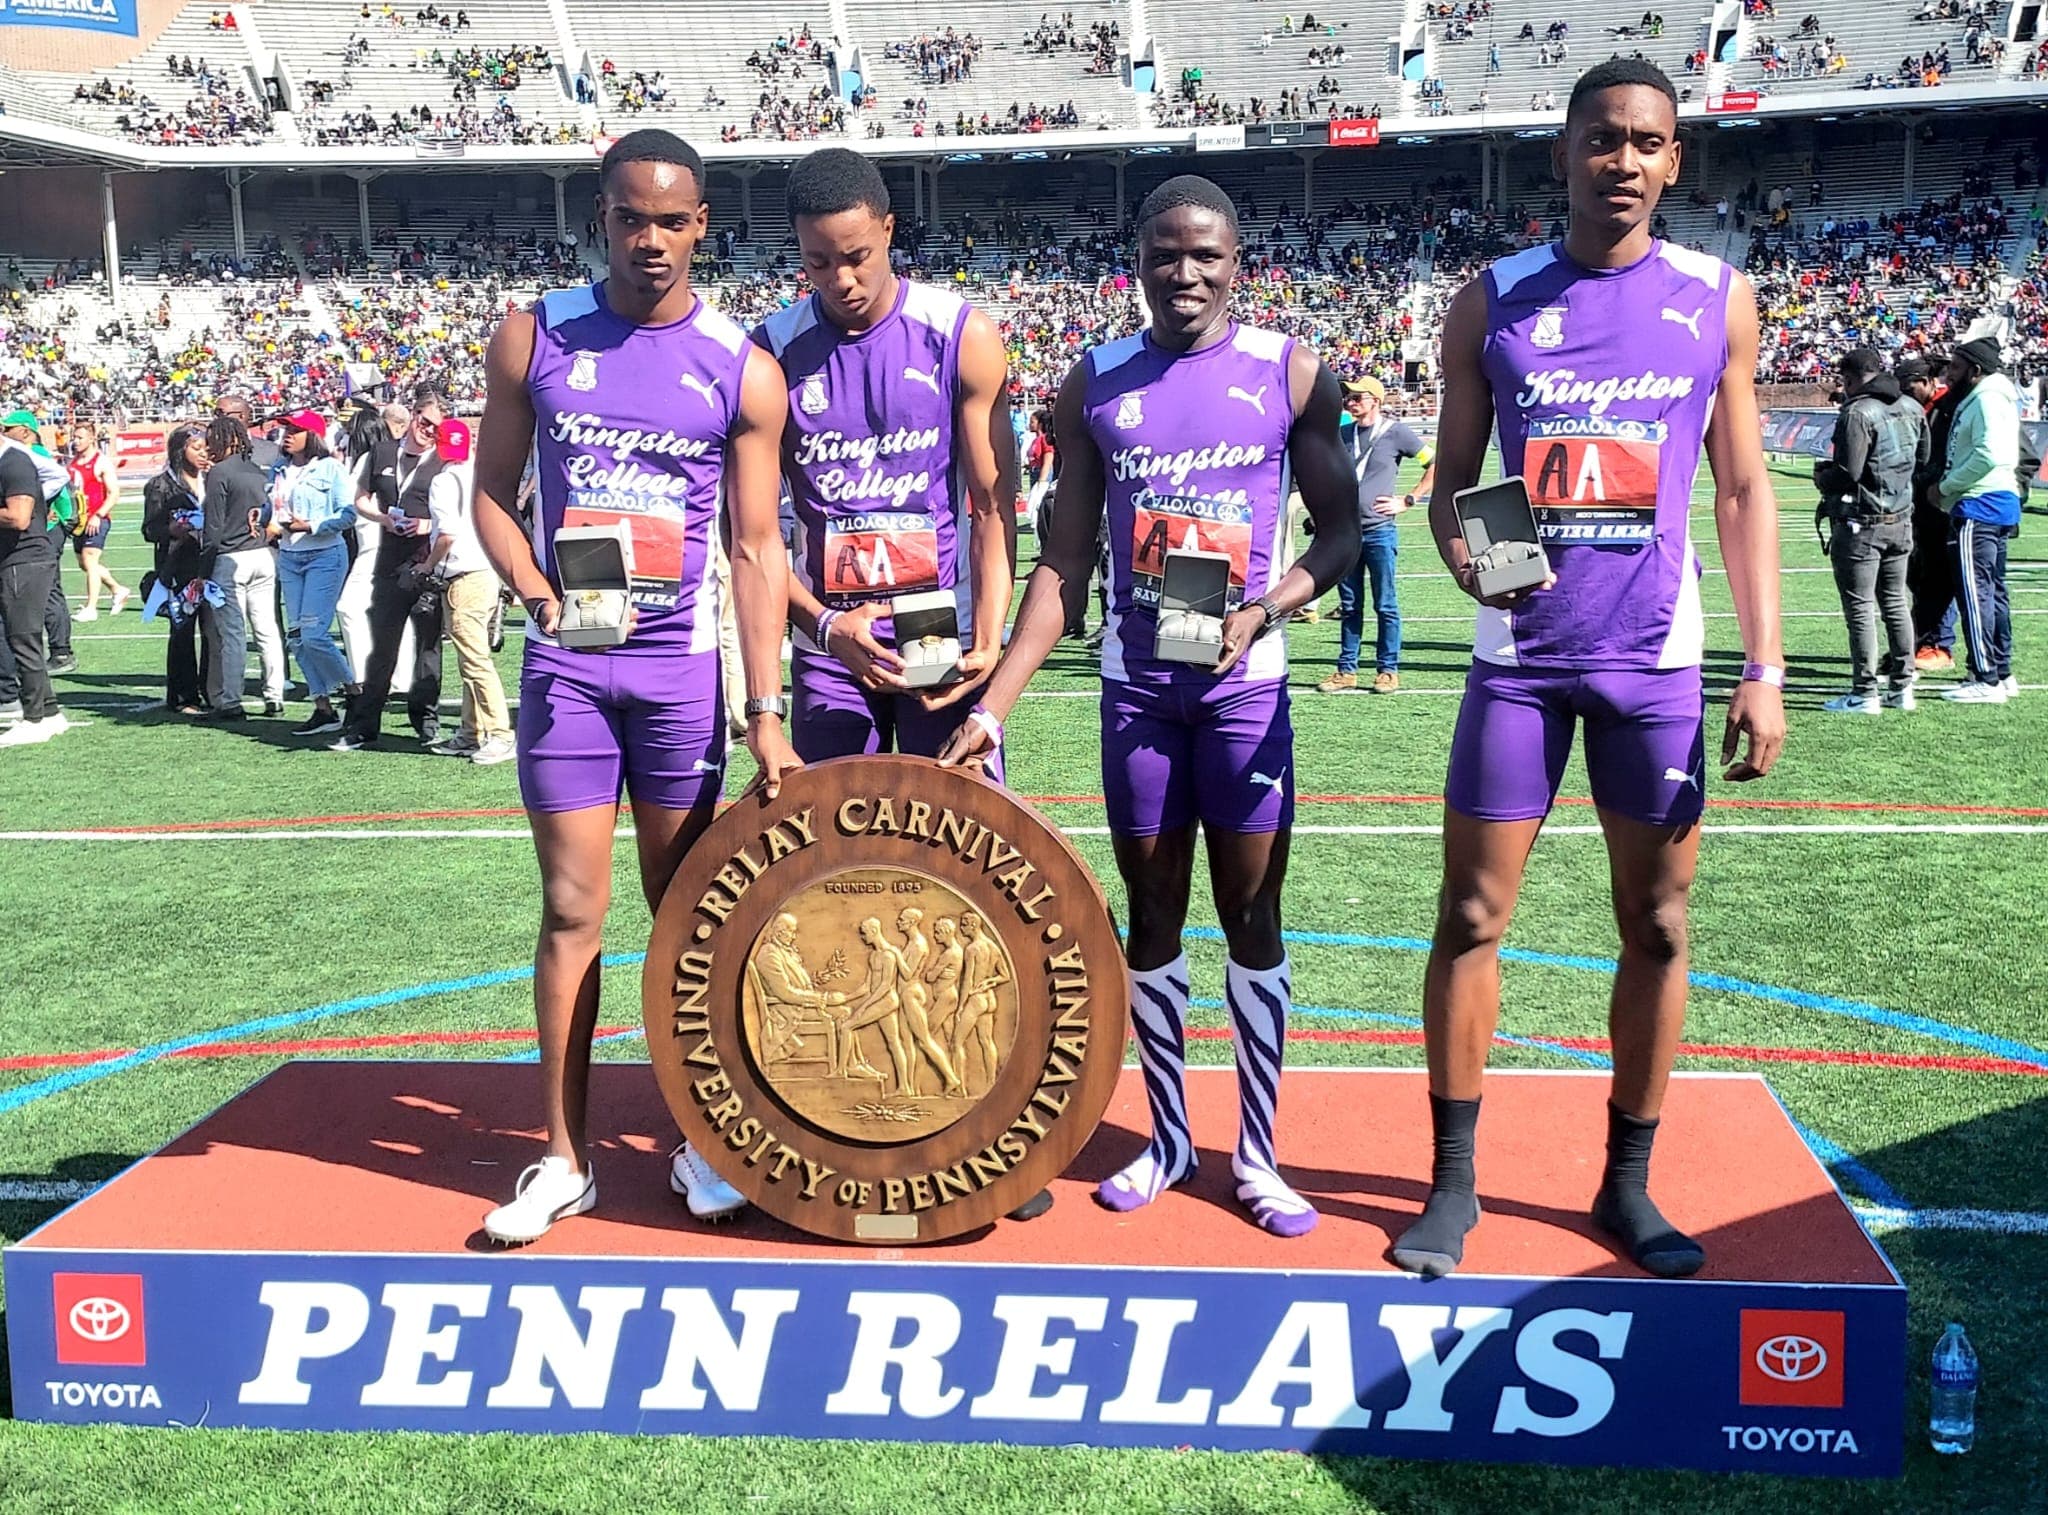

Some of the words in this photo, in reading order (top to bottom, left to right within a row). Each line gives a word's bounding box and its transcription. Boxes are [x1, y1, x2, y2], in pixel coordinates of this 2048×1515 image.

[1516, 368, 1694, 414] Kingston
[549, 411, 709, 460] Kingston
[1540, 418, 1617, 436] TOYOTA
[794, 426, 939, 468] Kingston
[566, 454, 688, 496] College
[1112, 440, 1266, 486] Kingston
[577, 491, 646, 512] TOYOTA
[816, 468, 929, 507] College
[1151, 495, 1216, 518] TOYOTA
[836, 515, 899, 532] TOYOTA
[1537, 524, 1598, 539] RELAY
[1599, 524, 1654, 539] PENN
[1133, 586, 1160, 603] AYS
[697, 808, 819, 927] RELAY
[837, 798, 1057, 921] CARNIVAL
[825, 881, 884, 894] FOUNDED
[892, 881, 922, 894] 1895
[674, 950, 834, 1200] UNIVERSITY
[838, 1179, 871, 1205] OF
[884, 941, 1091, 1211] PENNSYLVANIA
[238, 1281, 799, 1411] PENN
[826, 1290, 1633, 1438] RELAYS
[45, 1382, 162, 1409] TOYOTA
[1721, 1425, 1858, 1455] TOYOTA
